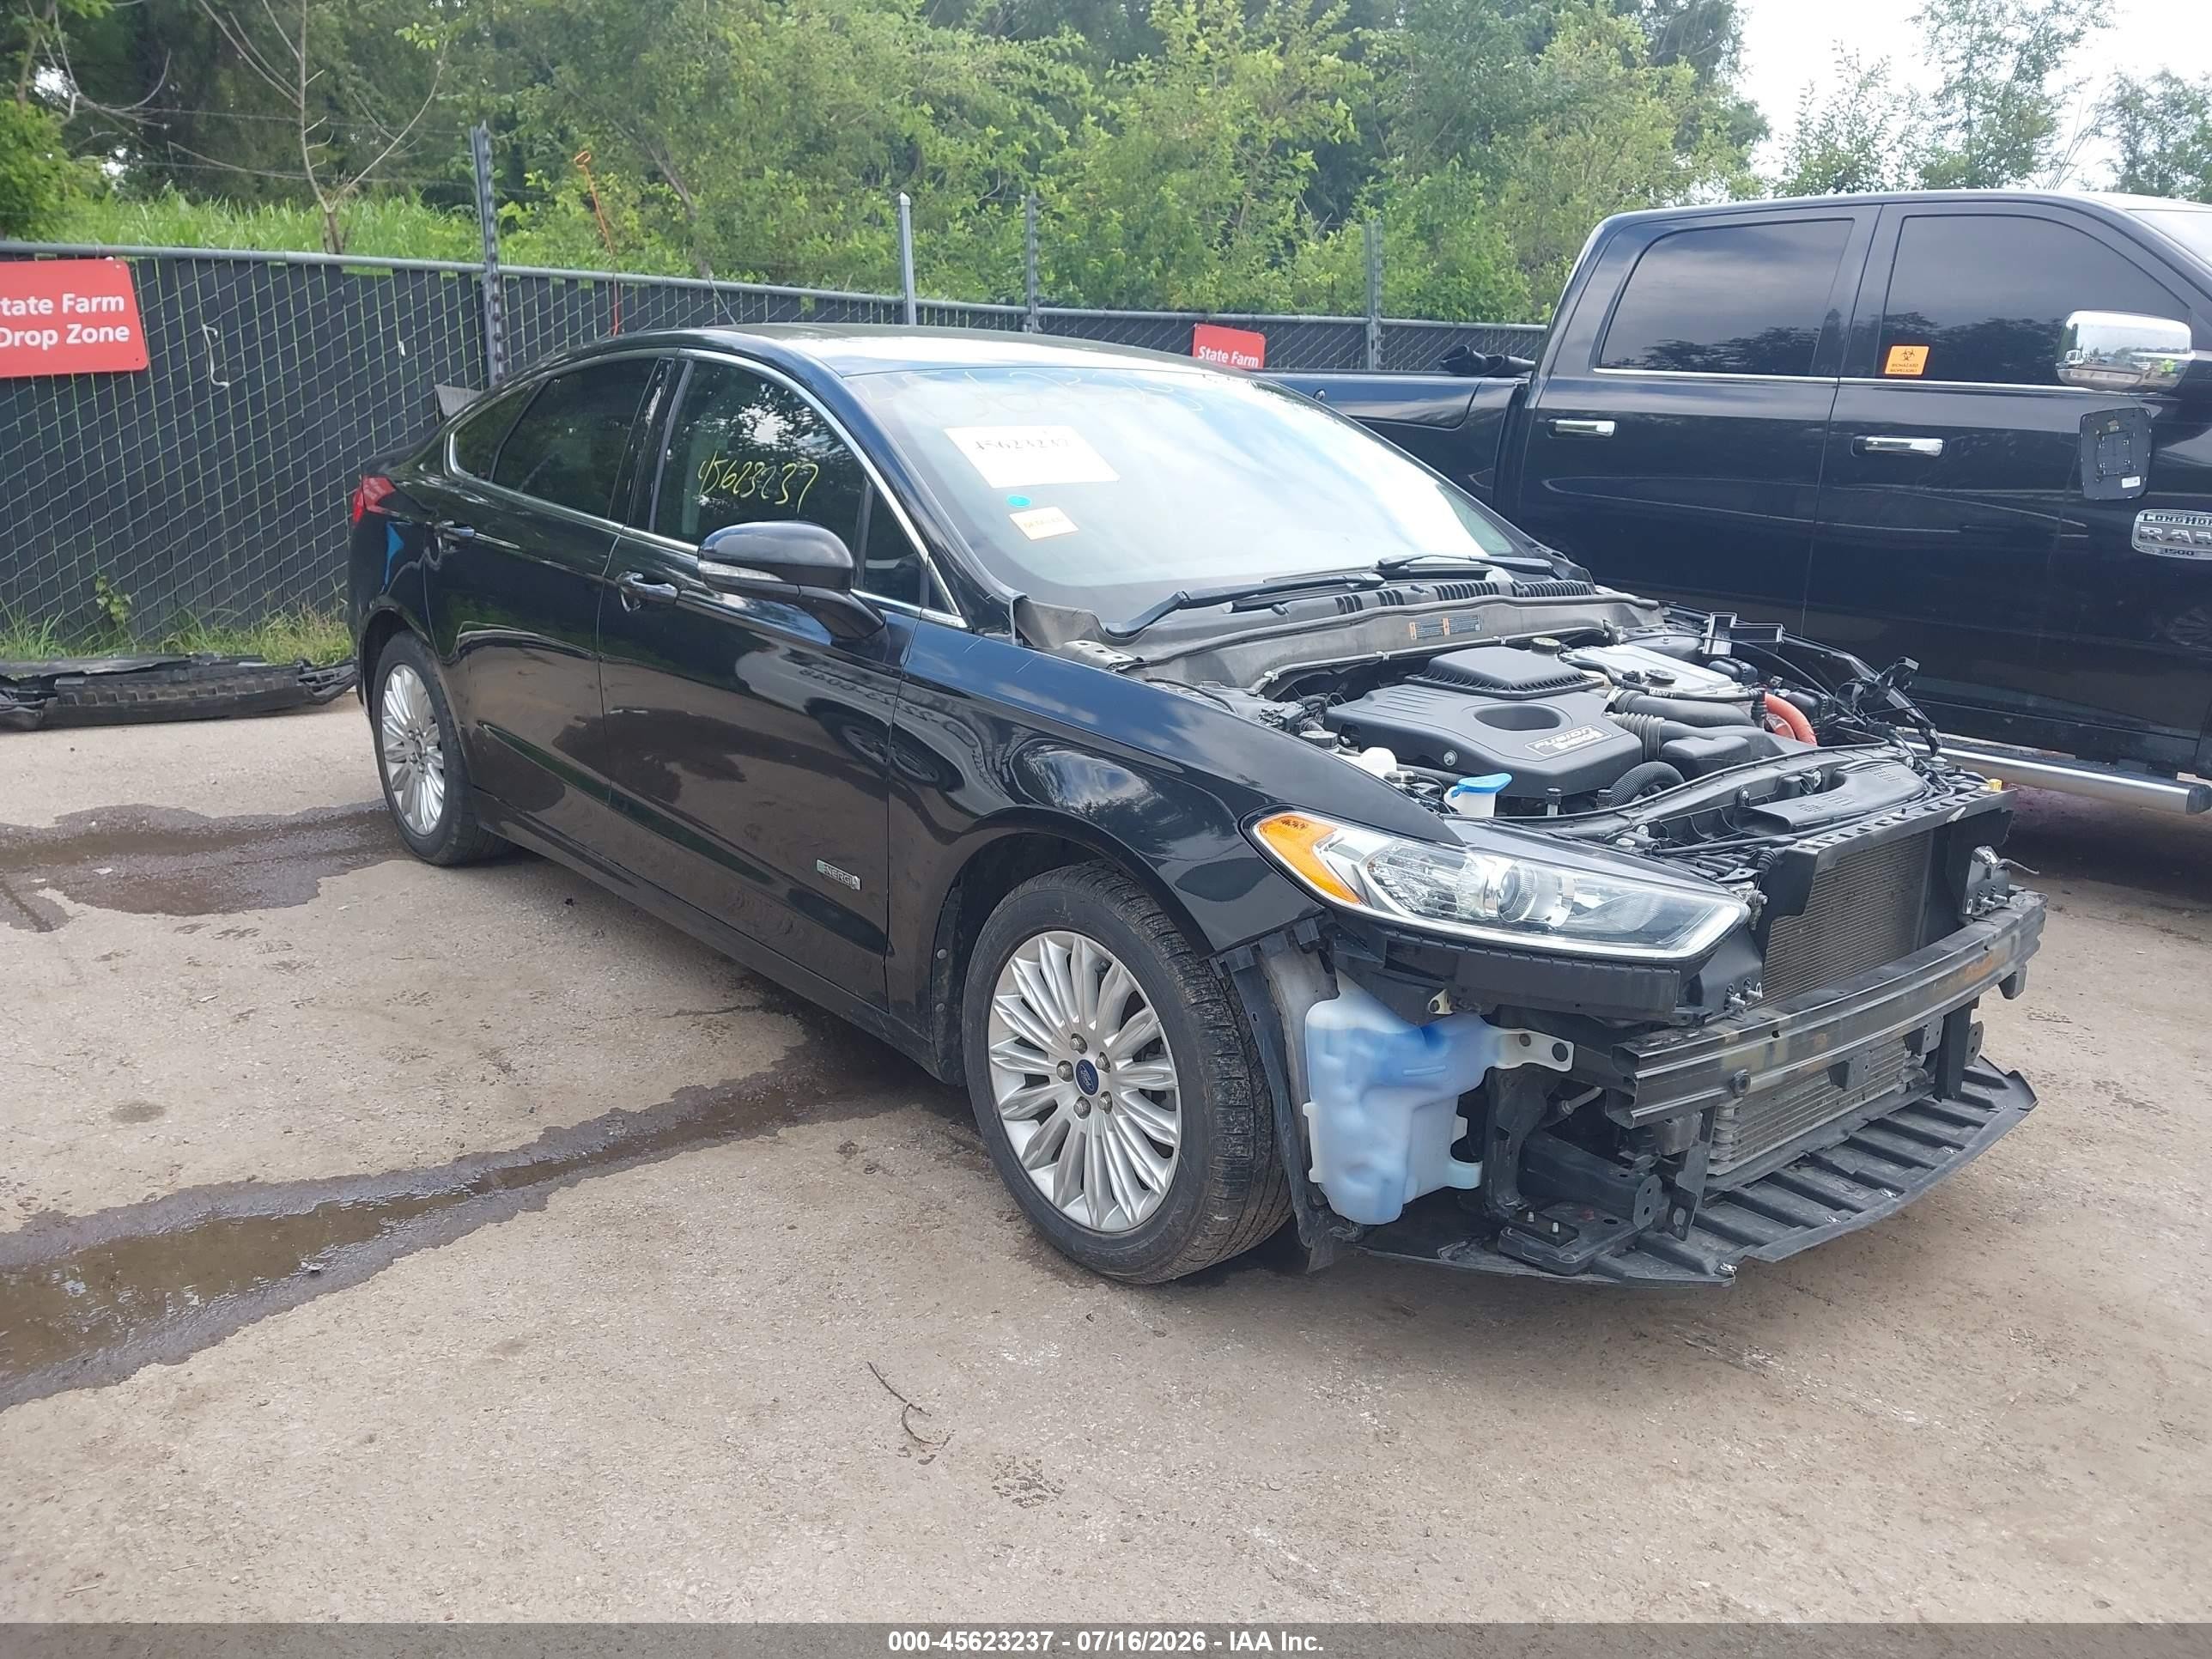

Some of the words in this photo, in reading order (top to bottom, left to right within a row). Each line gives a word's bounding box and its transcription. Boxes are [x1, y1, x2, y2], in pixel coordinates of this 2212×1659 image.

[0, 296, 53, 316] tate
[62, 293, 125, 313] Farm
[0, 327, 58, 350] Drop
[66, 324, 130, 344] Zone
[1198, 346, 1229, 363] State
[1231, 351, 1259, 368] Farm
[2164, 548, 2194, 556] 1500
